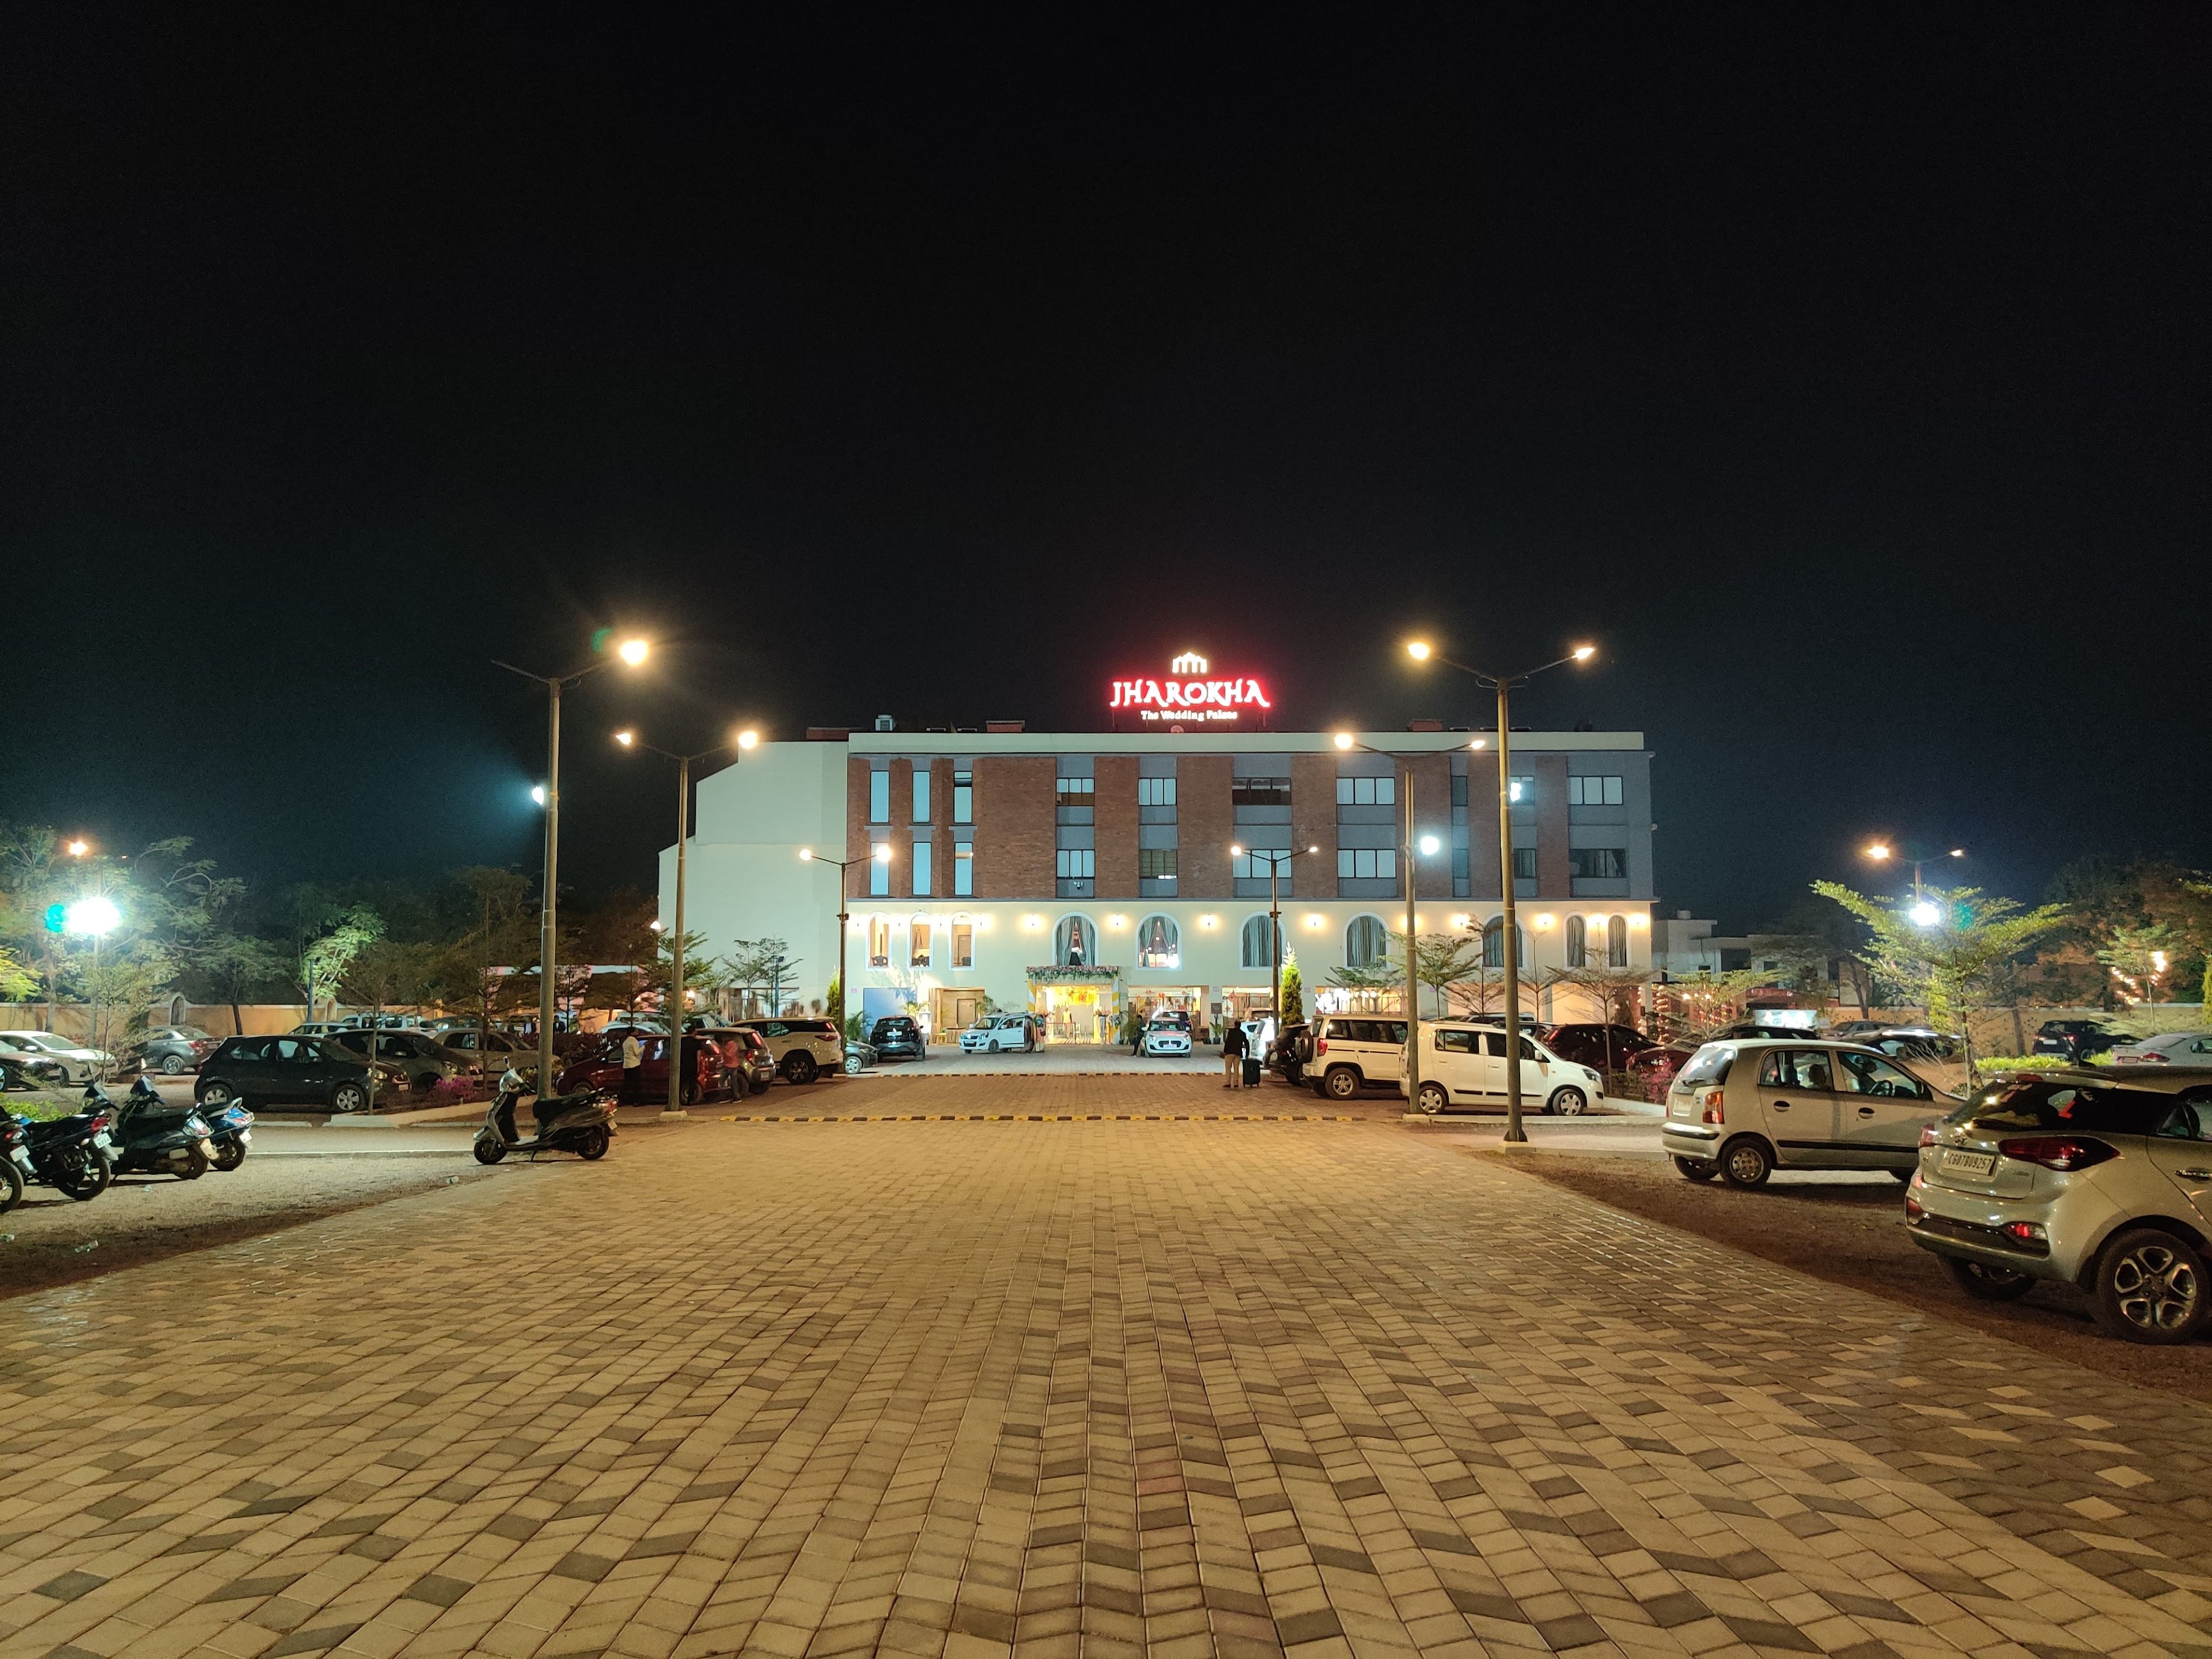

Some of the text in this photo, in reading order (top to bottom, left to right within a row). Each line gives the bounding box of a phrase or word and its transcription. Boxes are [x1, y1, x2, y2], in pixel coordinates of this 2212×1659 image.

[1110, 679, 1271, 707] JHAROKHA
[1140, 710, 1159, 720] The
[1160, 710, 1205, 722] Wedding
